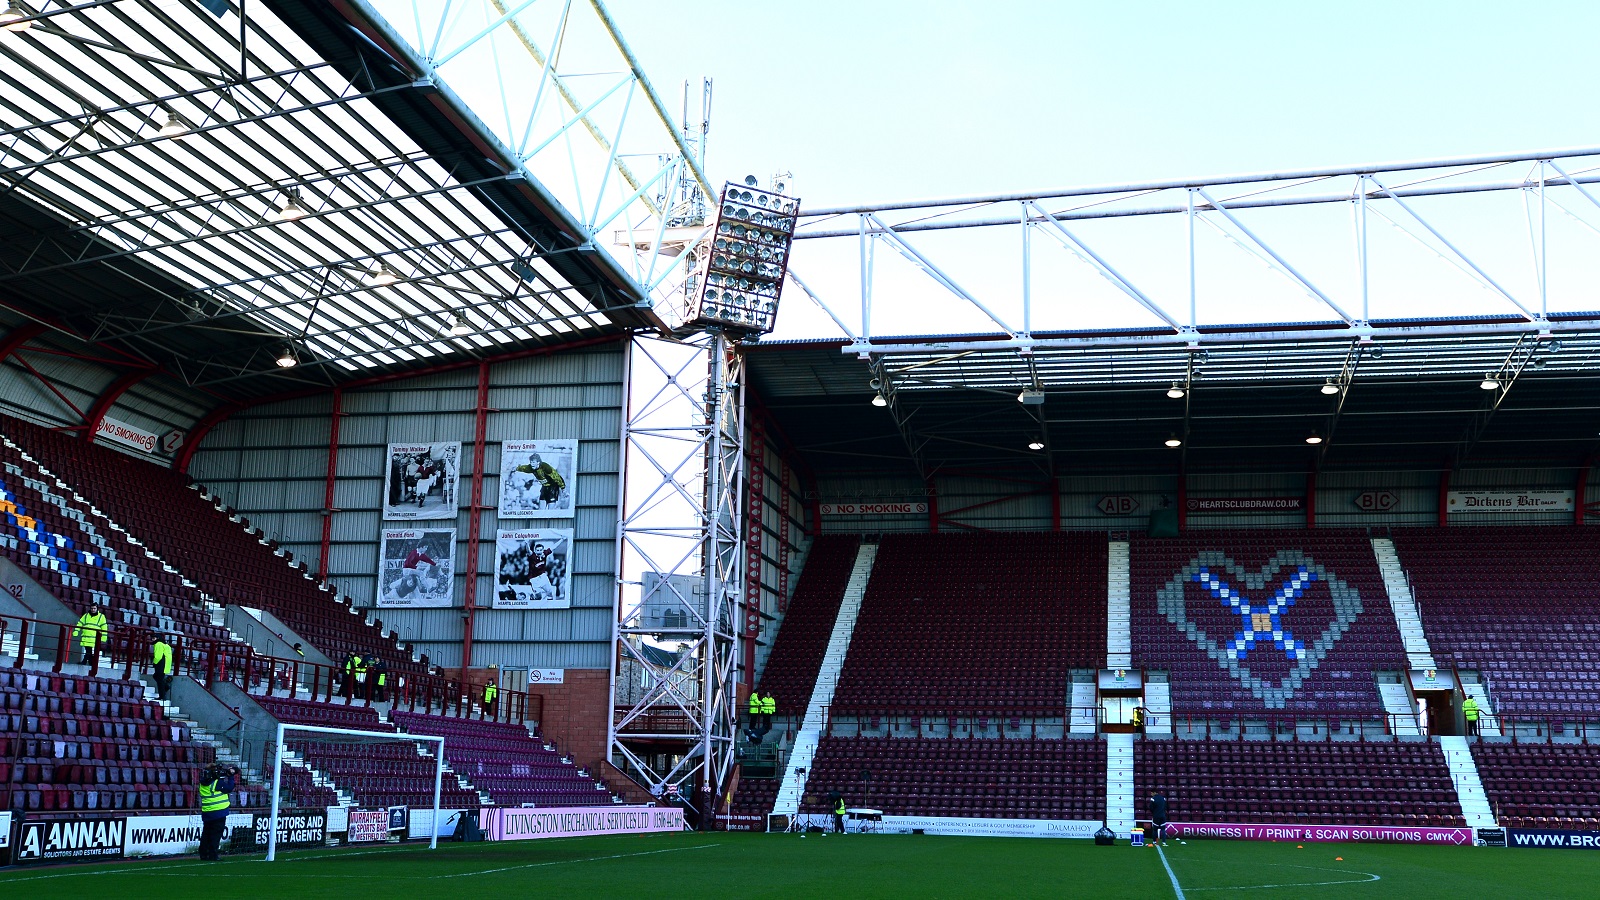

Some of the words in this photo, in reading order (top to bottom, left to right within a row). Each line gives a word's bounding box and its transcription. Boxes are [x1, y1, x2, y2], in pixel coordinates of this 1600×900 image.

[103, 422, 115, 434] NO
[115, 426, 146, 445] SMOKING
[166, 433, 180, 449] Z
[1105, 497, 1116, 511] A
[1120, 497, 1131, 511] B
[1199, 499, 1300, 510] HEARTSCLUBDRAW.CO.UK
[1362, 492, 1374, 508] B
[1379, 492, 1391, 508] C
[1465, 496, 1512, 507] Dickens
[1516, 495, 1541, 508] Bar
[837, 504, 855, 513] NO
[860, 504, 911, 513] SMOKING
[10, 584, 23, 597] 32
[256, 816, 306, 831] SOCITORS
[306, 816, 324, 830] AND
[350, 812, 388, 825] MURRAYFIELD
[506, 812, 558, 835] LIVINGSTON
[560, 811, 606, 832] MECHANICAL
[607, 811, 636, 831] SERVICES
[638, 811, 649, 829] LTD
[356, 824, 376, 834] SPORTS
[376, 824, 387, 833] BAR
[1047, 823, 1092, 832] DALMAHOY
[1184, 827, 1242, 838] BUSINESS
[1245, 828, 1256, 838] IT
[1266, 828, 1300, 839] PRINT
[1305, 830, 1312, 839] &
[1316, 830, 1348, 840] SCAN
[1352, 831, 1422, 841] SOLUTIONS
[45, 820, 123, 850] ANNAN
[290, 828, 322, 843] AGENTS
